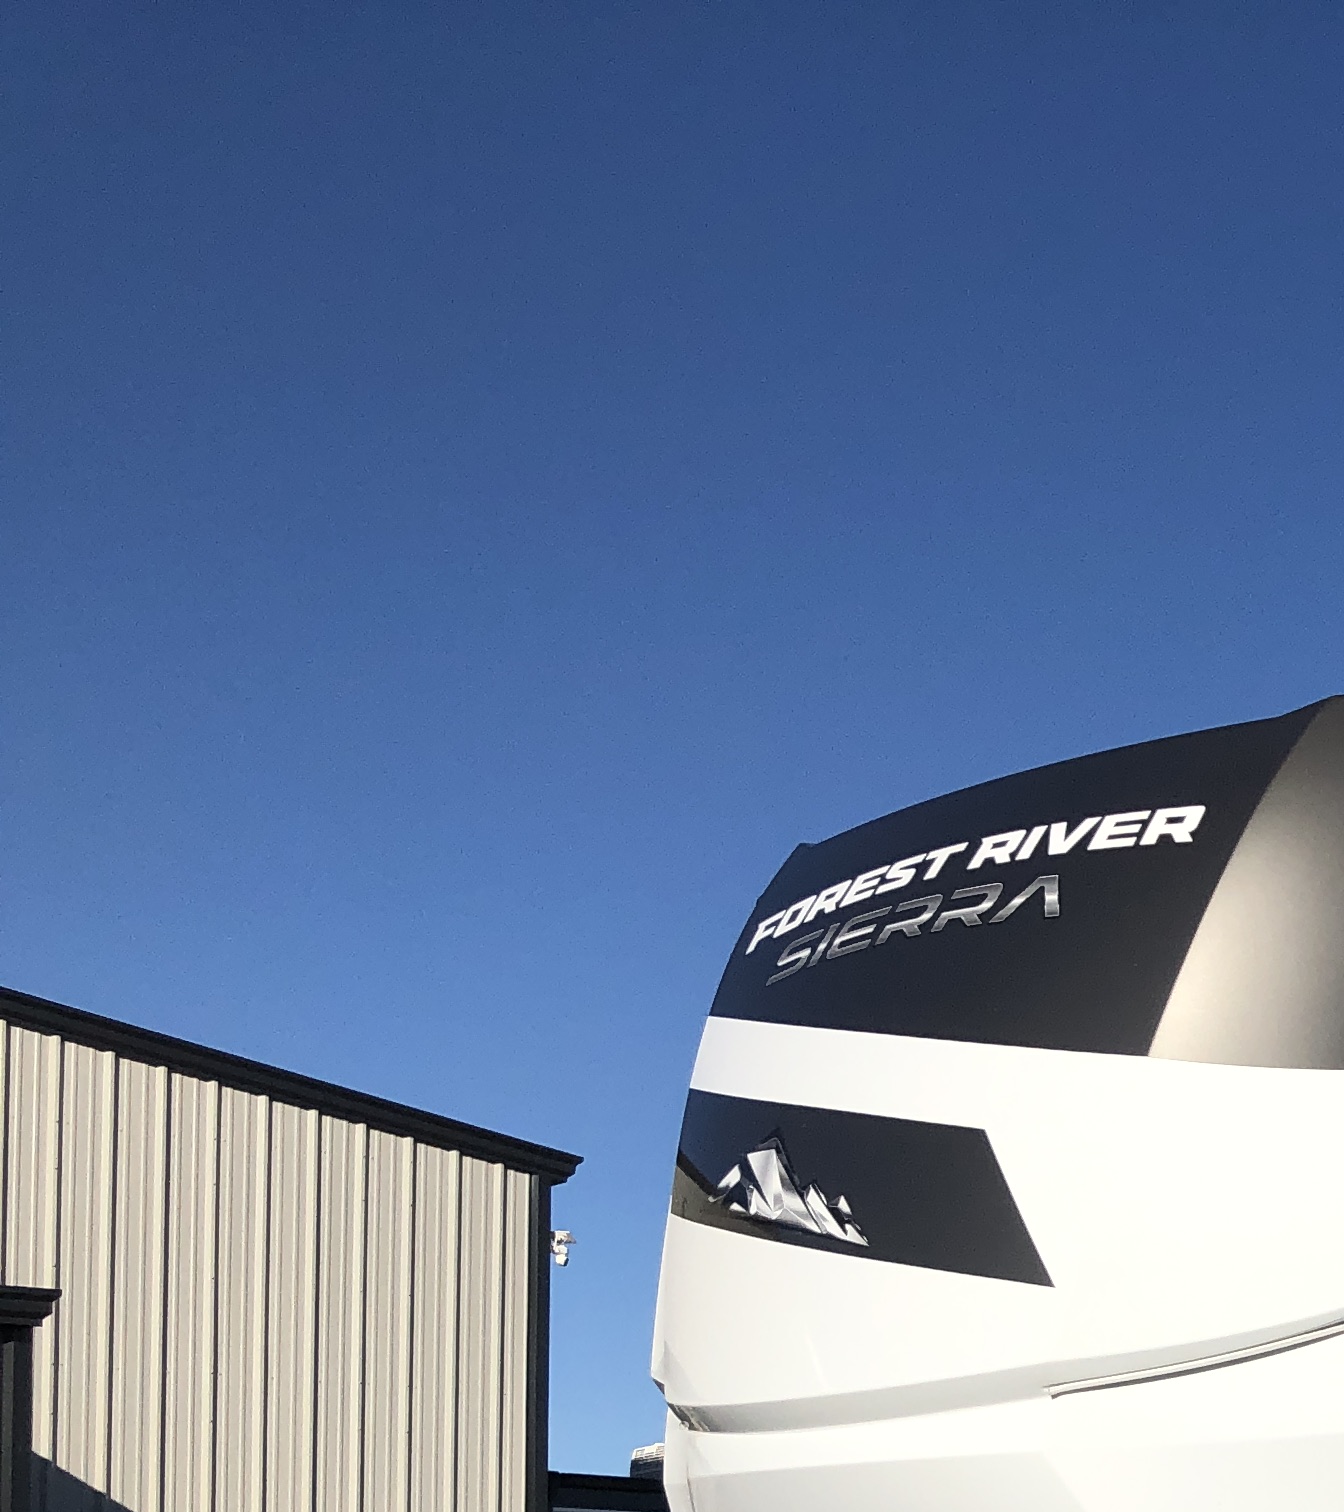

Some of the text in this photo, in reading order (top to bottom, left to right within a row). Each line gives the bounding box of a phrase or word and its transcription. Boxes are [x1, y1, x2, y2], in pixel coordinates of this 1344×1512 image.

[744, 804, 1206, 955] FOREST RIVER
[765, 874, 1060, 987] SIERRA
